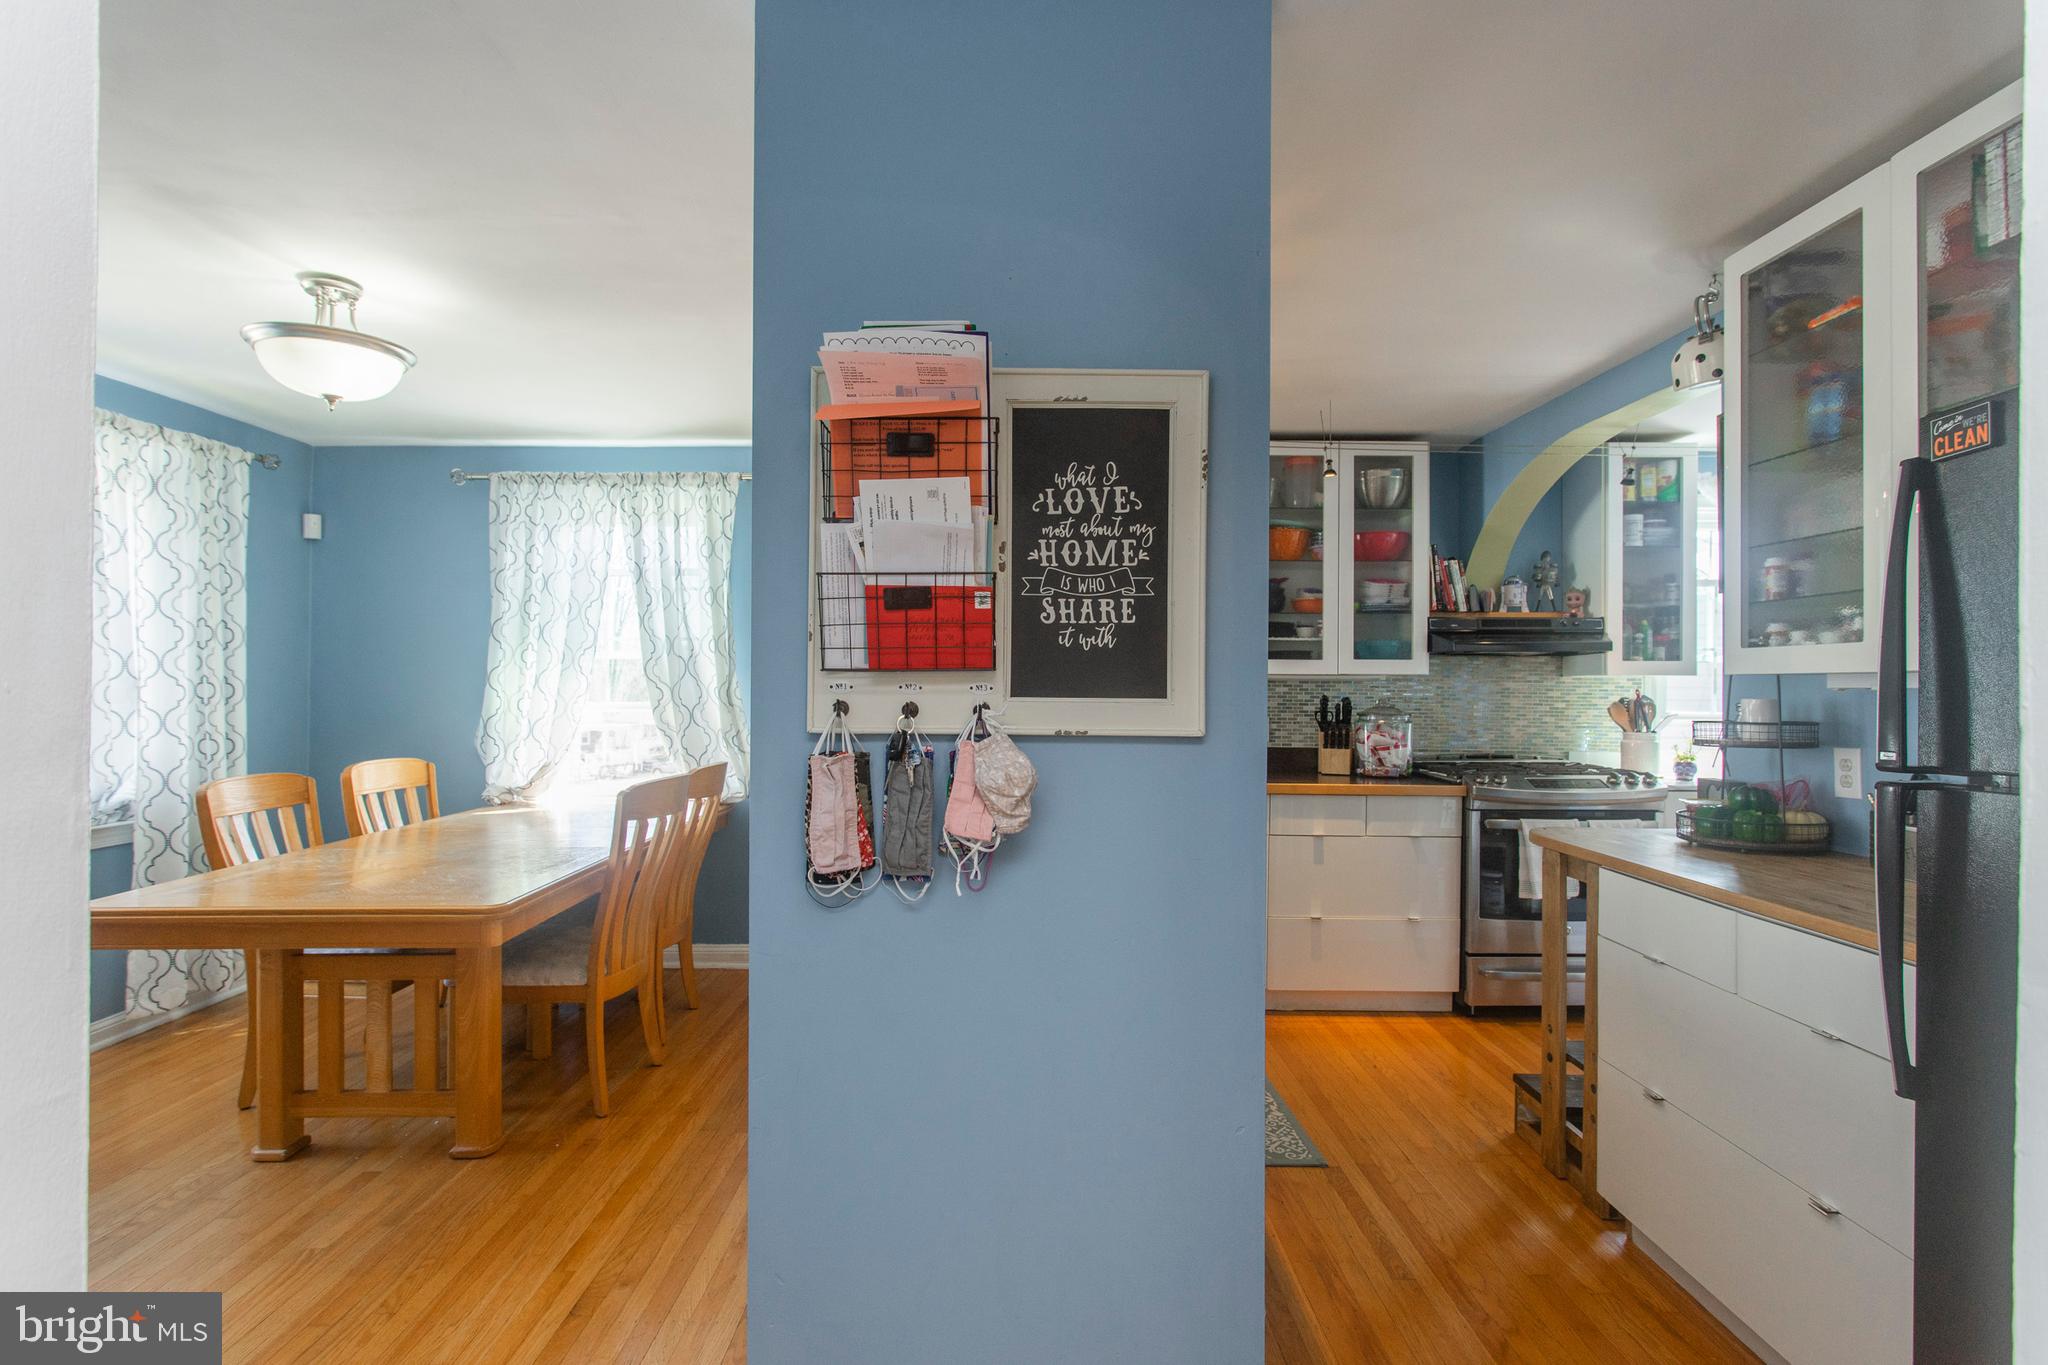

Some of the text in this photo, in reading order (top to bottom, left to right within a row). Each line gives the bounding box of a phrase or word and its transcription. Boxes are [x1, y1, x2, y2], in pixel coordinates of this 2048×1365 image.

[1933, 420, 1954, 436] Come
[1961, 412, 1987, 428] WE'RE
[1934, 423, 1988, 456] CLEAN
[1054, 461, 1119, 490] what I
[1045, 486, 1130, 515] LOVE
[1041, 513, 1156, 547] most about my
[1038, 539, 1138, 567] HOME
[1060, 575, 1116, 593] IS WHO I
[1040, 597, 1136, 624] SHARE
[1058, 623, 1117, 651] it with
